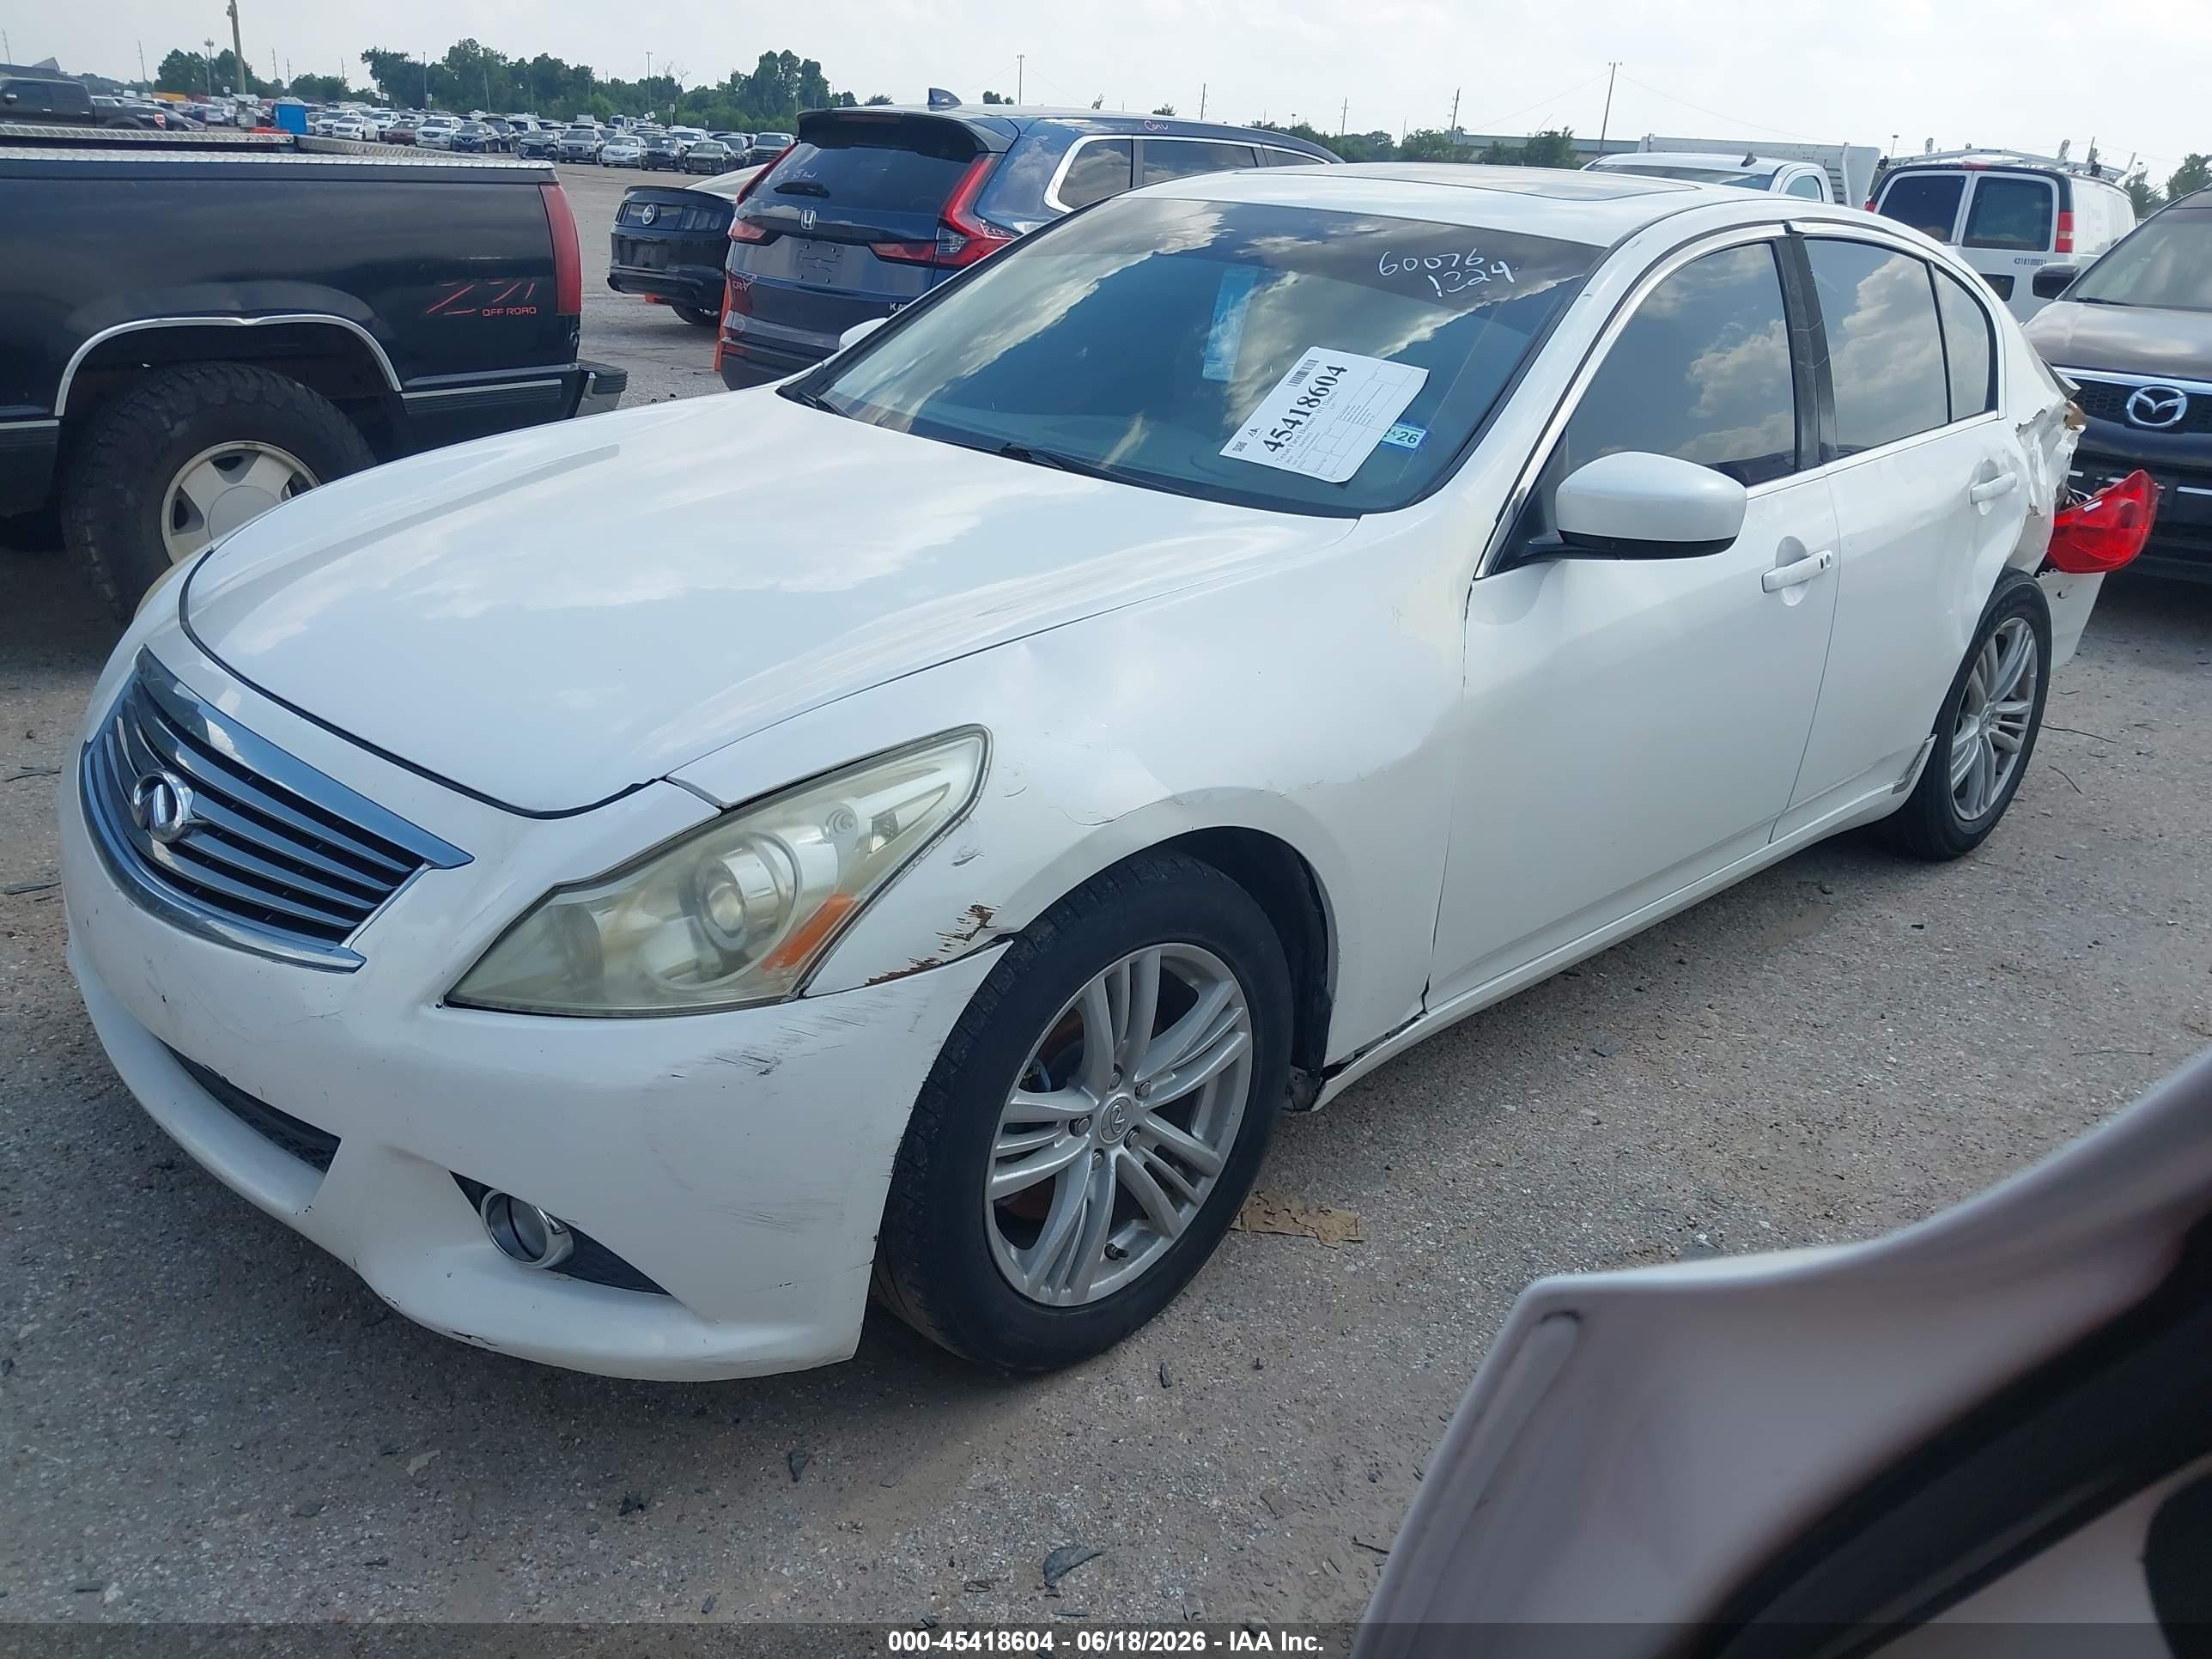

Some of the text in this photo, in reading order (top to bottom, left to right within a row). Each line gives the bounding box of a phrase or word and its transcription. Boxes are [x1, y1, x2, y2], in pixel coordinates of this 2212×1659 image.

[1379, 248, 1485, 276] 60076
[427, 281, 535, 315] Z71
[482, 306, 537, 317] OFF ROAD
[1262, 365, 1348, 453] 45418604
[1395, 431, 1419, 444] 26
